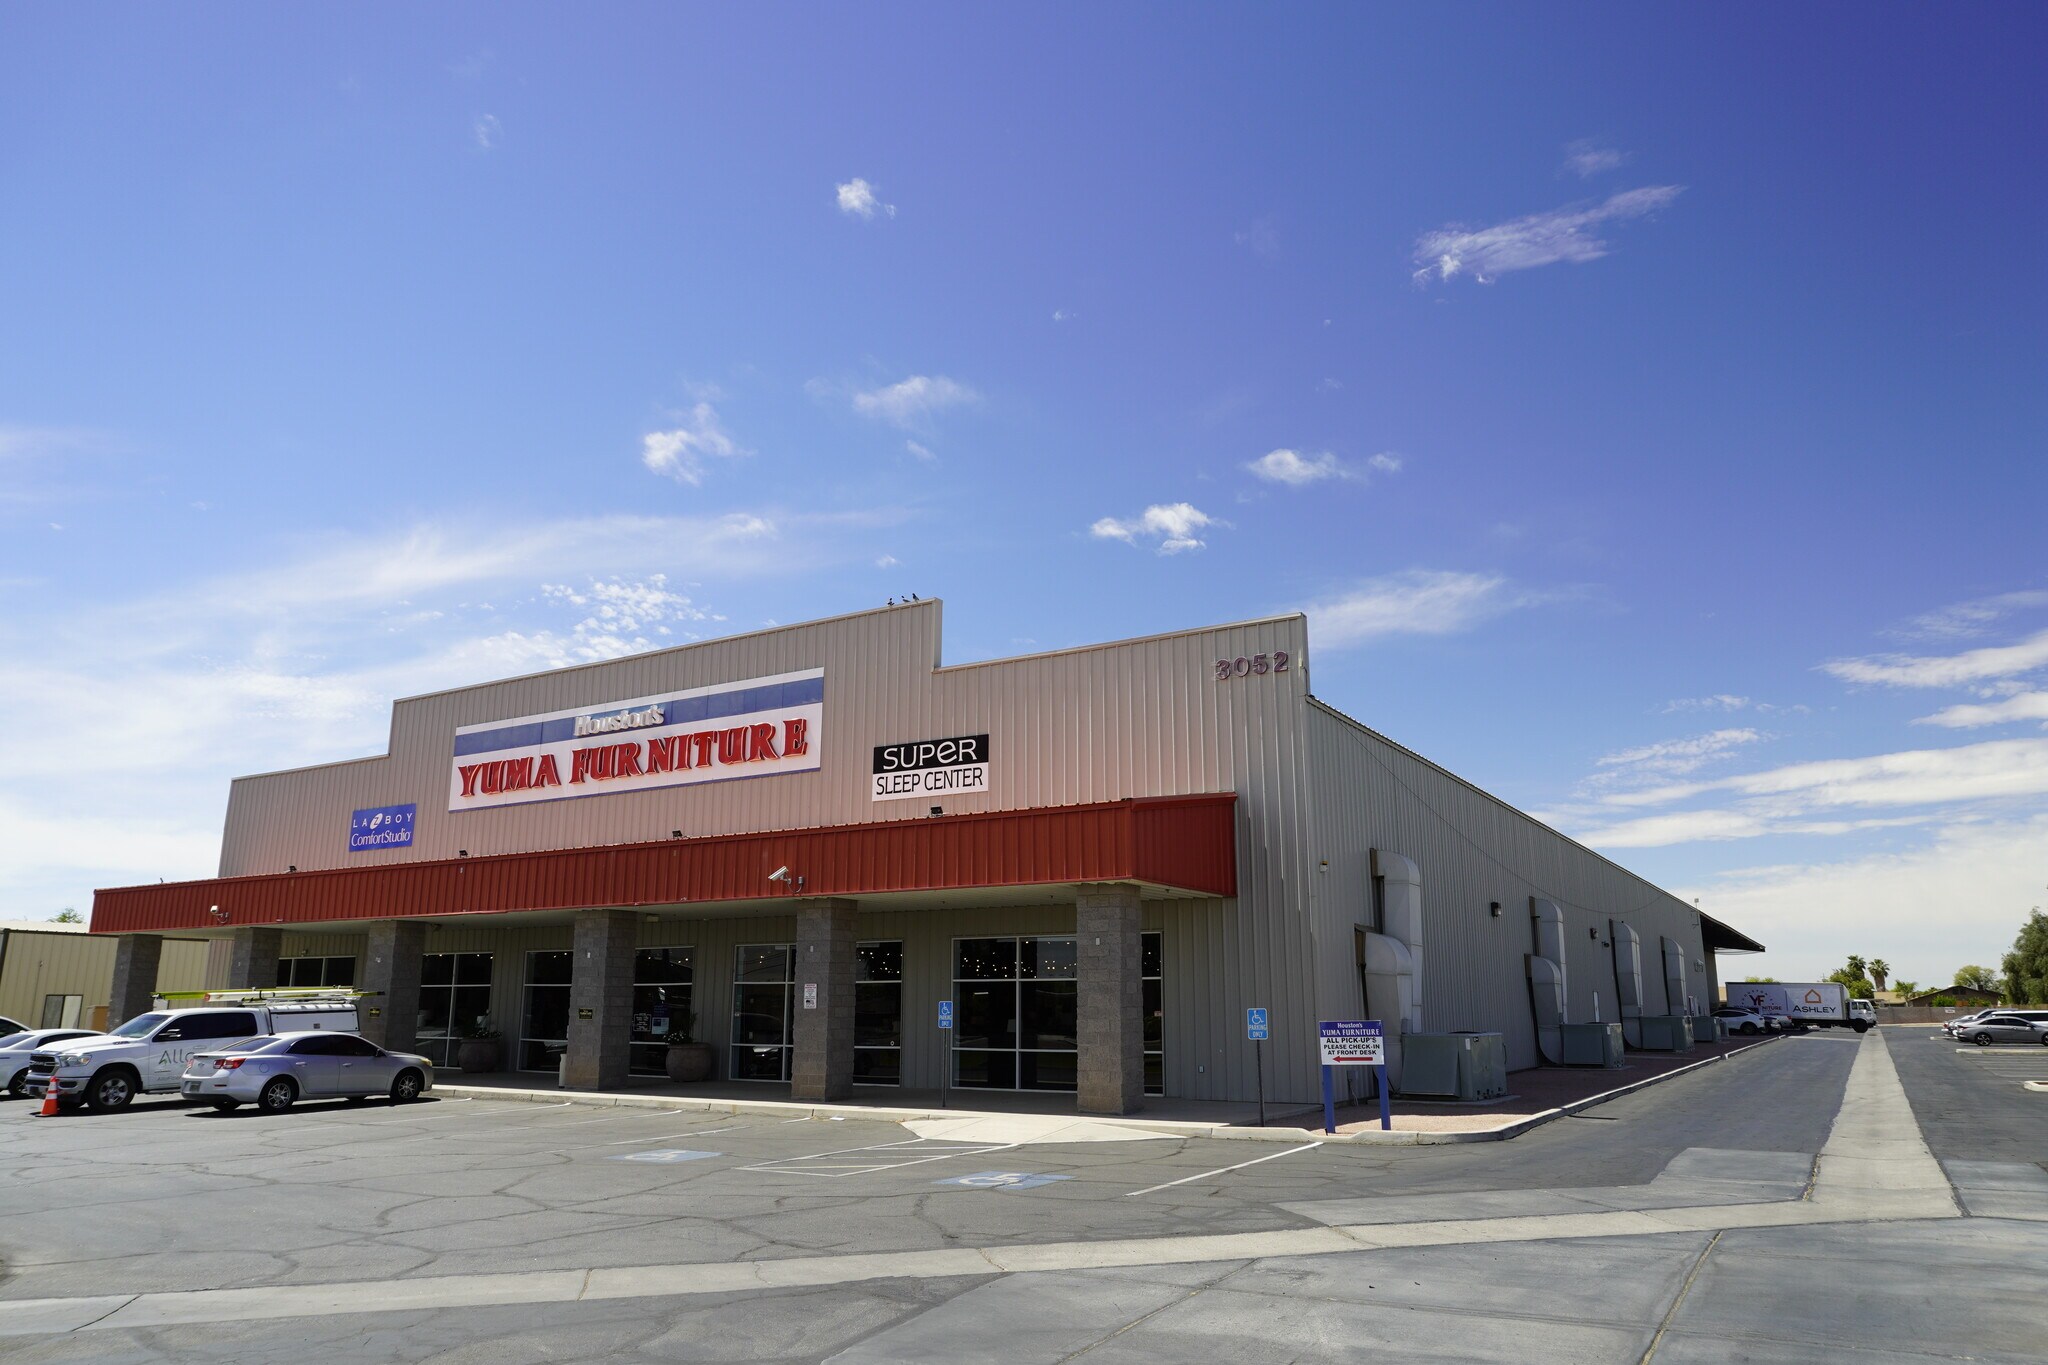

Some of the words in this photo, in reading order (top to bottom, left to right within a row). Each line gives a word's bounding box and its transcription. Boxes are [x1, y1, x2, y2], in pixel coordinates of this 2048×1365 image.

[1215, 650, 1289, 681] 3052
[574, 704, 666, 737] Houston's
[458, 753, 562, 798] YUMA
[568, 717, 809, 785] FURNITURE
[876, 773, 921, 796] SLEEP
[924, 767, 983, 791] CENTER
[1748, 994, 1766, 1006] YF
[1793, 1005, 1836, 1013] ASHLEY
